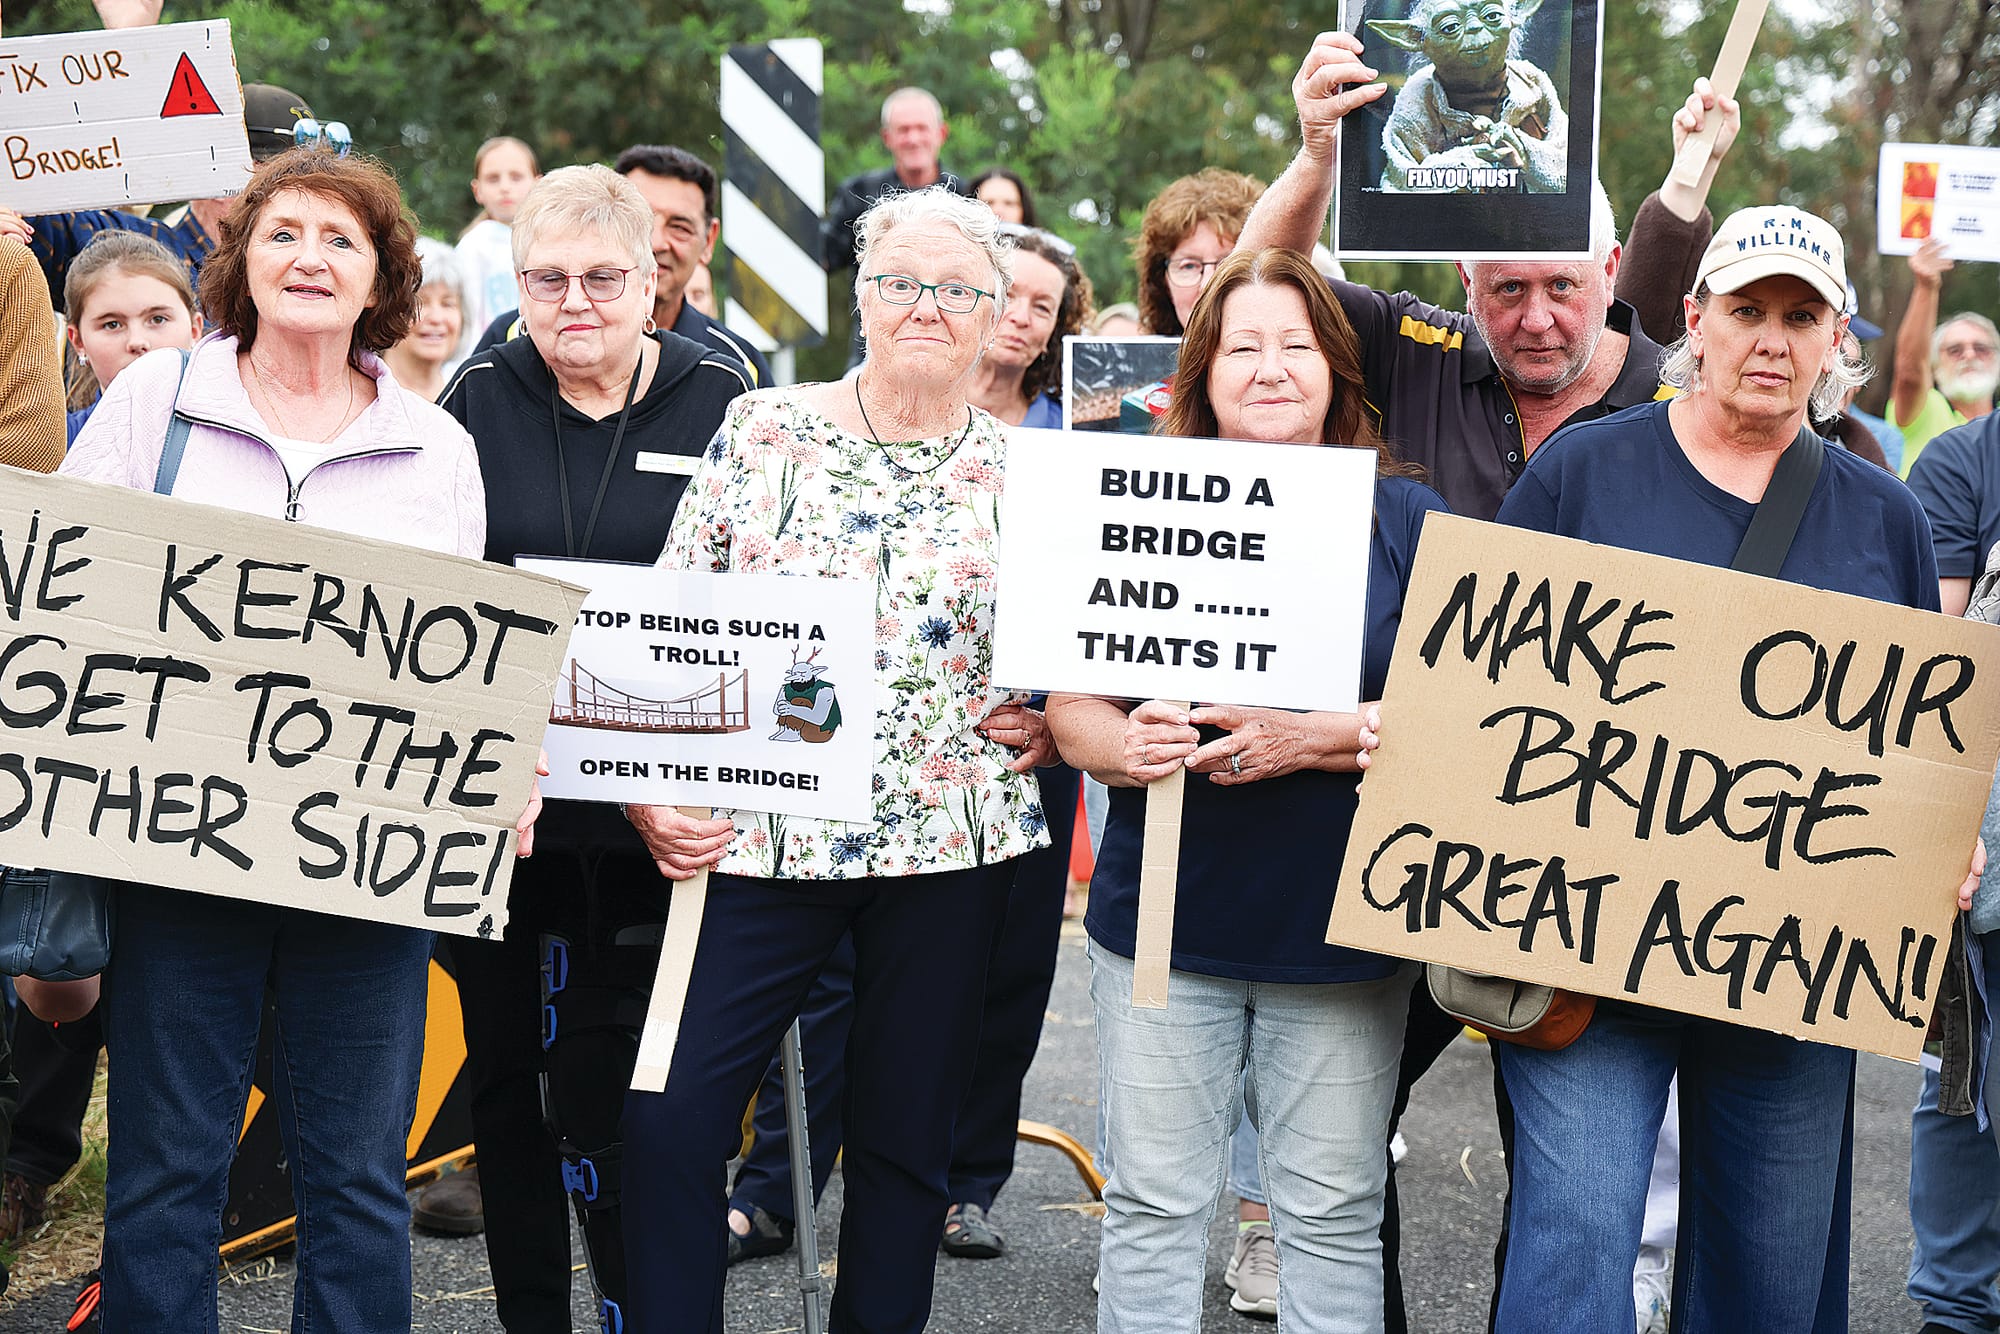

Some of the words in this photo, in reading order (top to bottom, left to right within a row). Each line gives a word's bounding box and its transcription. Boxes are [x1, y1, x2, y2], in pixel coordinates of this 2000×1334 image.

[62, 50, 130, 85] OUR
[4, 135, 122, 180] BRIDGE!
[1407, 168, 1434, 188] FIX
[1435, 168, 1469, 188] YOU
[1471, 168, 1519, 188] MUST
[1736, 231, 1831, 265] WILLIAMS
[1100, 468, 1231, 503] BUILD
[1244, 477, 1275, 507] A
[1101, 523, 1266, 562] BRIDGE
[1087, 577, 1180, 611] AND
[158, 544, 559, 686] KERNOT
[574, 609, 631, 629] TOP
[640, 613, 719, 636] BEING
[728, 619, 800, 640] SUCH
[808, 624, 826, 641] A
[649, 644, 740, 667] TROLL!
[1077, 631, 1219, 669] THATS
[1235, 642, 1277, 672] IT
[1419, 571, 1676, 706] MAKE
[1740, 629, 1976, 759] OUR
[0, 634, 211, 743] GET
[234, 671, 333, 768] TO
[347, 701, 516, 808] THE
[579, 759, 649, 778] OPEN
[657, 763, 709, 782] THE
[717, 767, 820, 791] BRIDGE!
[1480, 706, 1897, 871] BRIDGE
[0, 753, 254, 872] OTHER
[291, 791, 510, 939] SIDE!
[1361, 822, 1620, 965] GREAT
[1623, 879, 1938, 1029] AGAIN!
